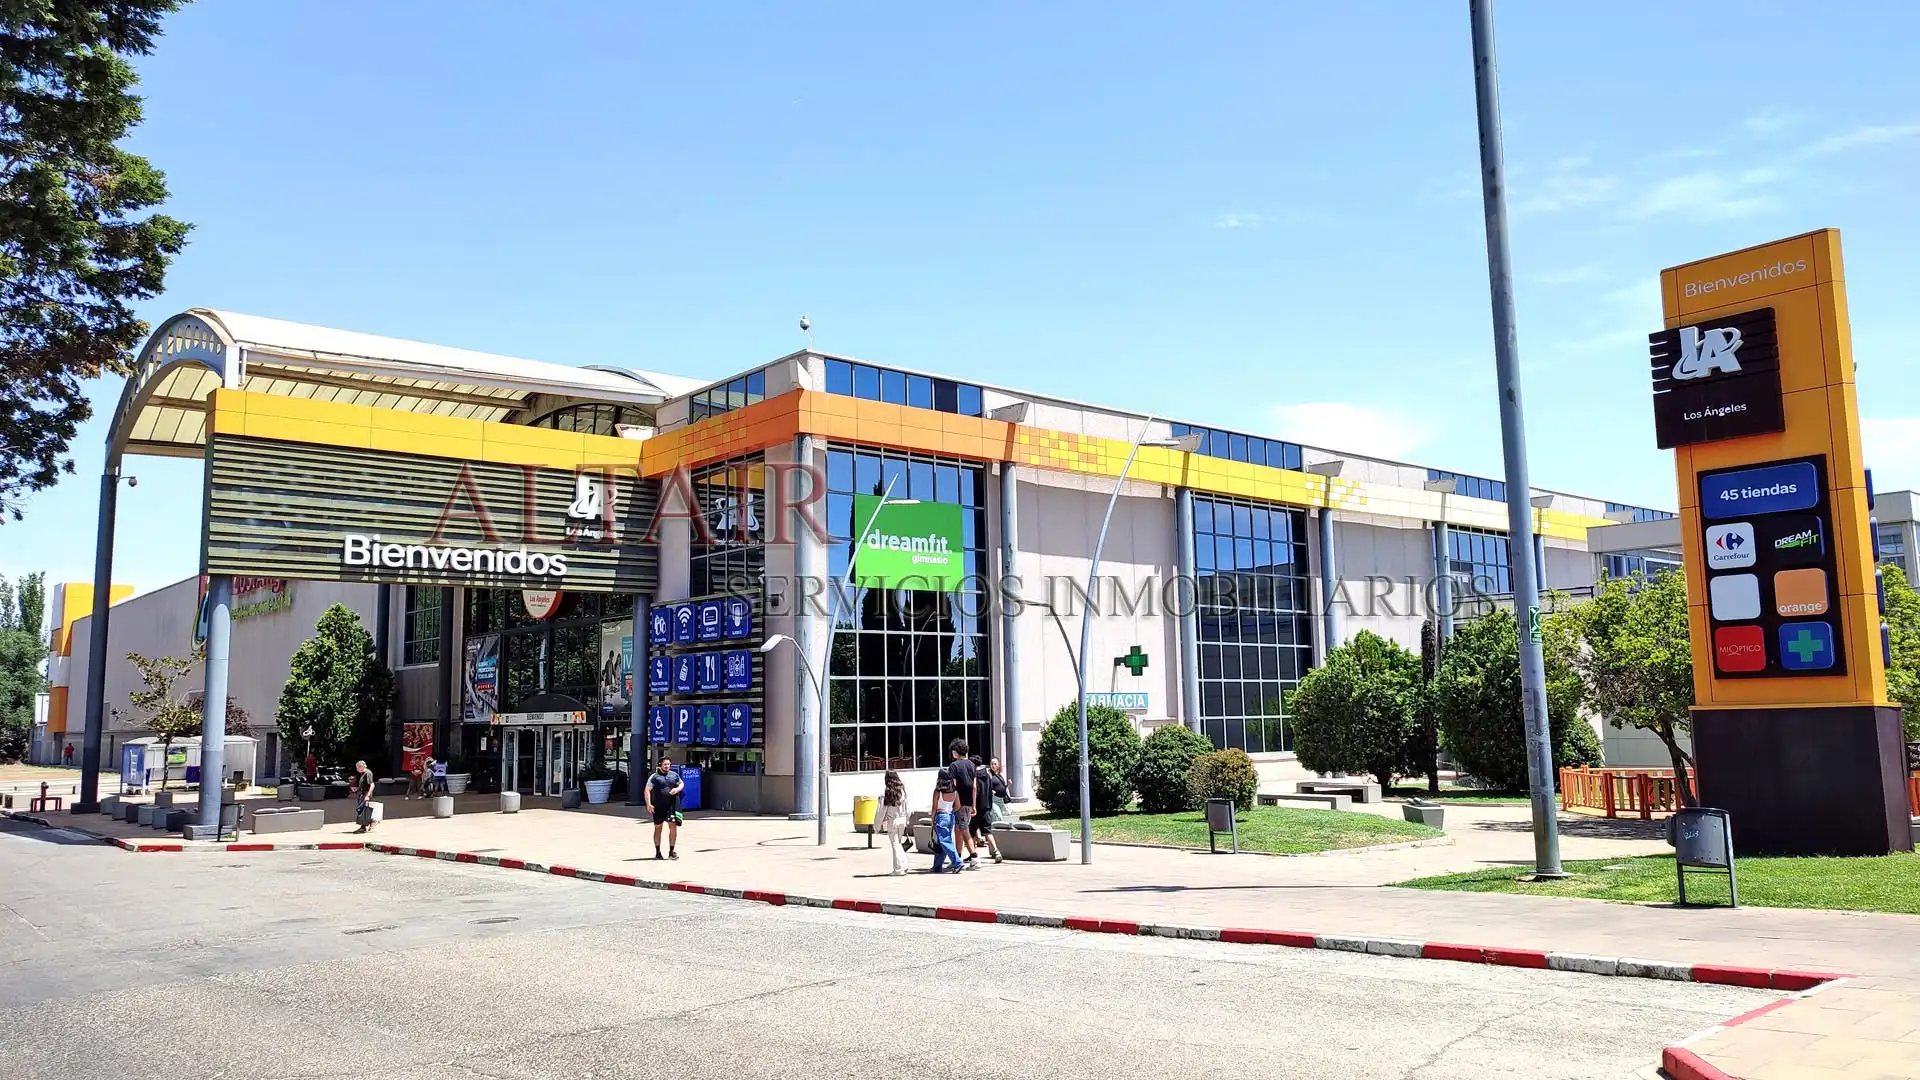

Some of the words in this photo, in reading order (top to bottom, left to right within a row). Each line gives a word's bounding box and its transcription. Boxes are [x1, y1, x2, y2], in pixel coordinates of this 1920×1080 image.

[1684, 258, 1808, 298] Bienvenidos
[1684, 410, 1703, 421] Los
[1703, 402, 1748, 417] Ángeles
[1720, 488, 1739, 501] 45
[1741, 483, 1798, 499] tiendas
[1774, 529, 1812, 549] DREAM
[343, 533, 568, 577] Bienvenidos
[911, 554, 949, 565] gimnasio
[1713, 552, 1750, 561] Carrefour
[1779, 602, 1823, 614] orange
